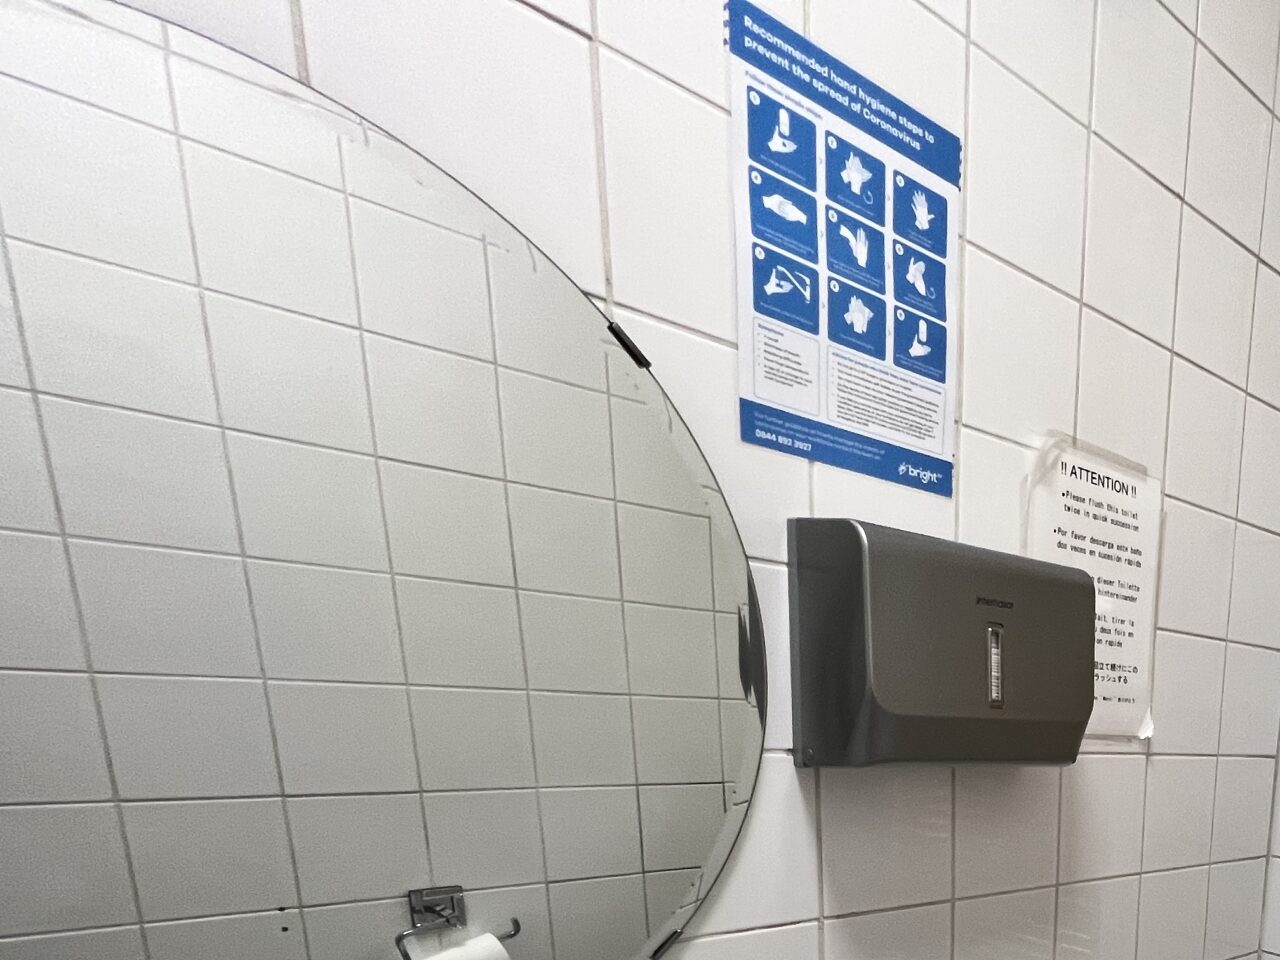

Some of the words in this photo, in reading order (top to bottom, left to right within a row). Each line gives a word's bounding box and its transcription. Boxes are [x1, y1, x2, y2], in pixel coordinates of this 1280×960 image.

[744, 15, 828, 76] Recommended
[831, 70, 856, 95] hand
[859, 86, 896, 120] hygiene
[899, 114, 923, 137] steps
[925, 129, 934, 143] to
[744, 36, 789, 70] prevent
[792, 63, 809, 82] the
[813, 79, 848, 106] spread
[850, 100, 861, 114] of
[863, 109, 921, 151] Coronavirus
[908, 464, 938, 483] bright
[1070, 465, 1129, 496] ATTENTION
[1066, 490, 1086, 504] Please
[1089, 497, 1104, 509] flush
[1107, 503, 1119, 514] this
[1121, 509, 1138, 520] toilet
[1064, 504, 1081, 516] twice
[1083, 509, 1090, 518] in
[1092, 512, 1108, 523] quick
[1110, 518, 1140, 532] succession
[1057, 527, 1068, 537] Por
[1071, 530, 1087, 541] favor
[1090, 536, 1114, 550] descarga
[1117, 544, 1128, 553] este
[1057, 541, 1067, 550] dos
[1070, 545, 1087, 555] veces
[1089, 549, 1096, 557] en
[1097, 576, 1115, 587] dieser
[1118, 580, 1141, 592] Toilette
[1100, 626, 1111, 635] deux
[1114, 628, 1126, 637] fois
[1112, 616, 1126, 625] tirer
[1105, 639, 1123, 648] rapide
